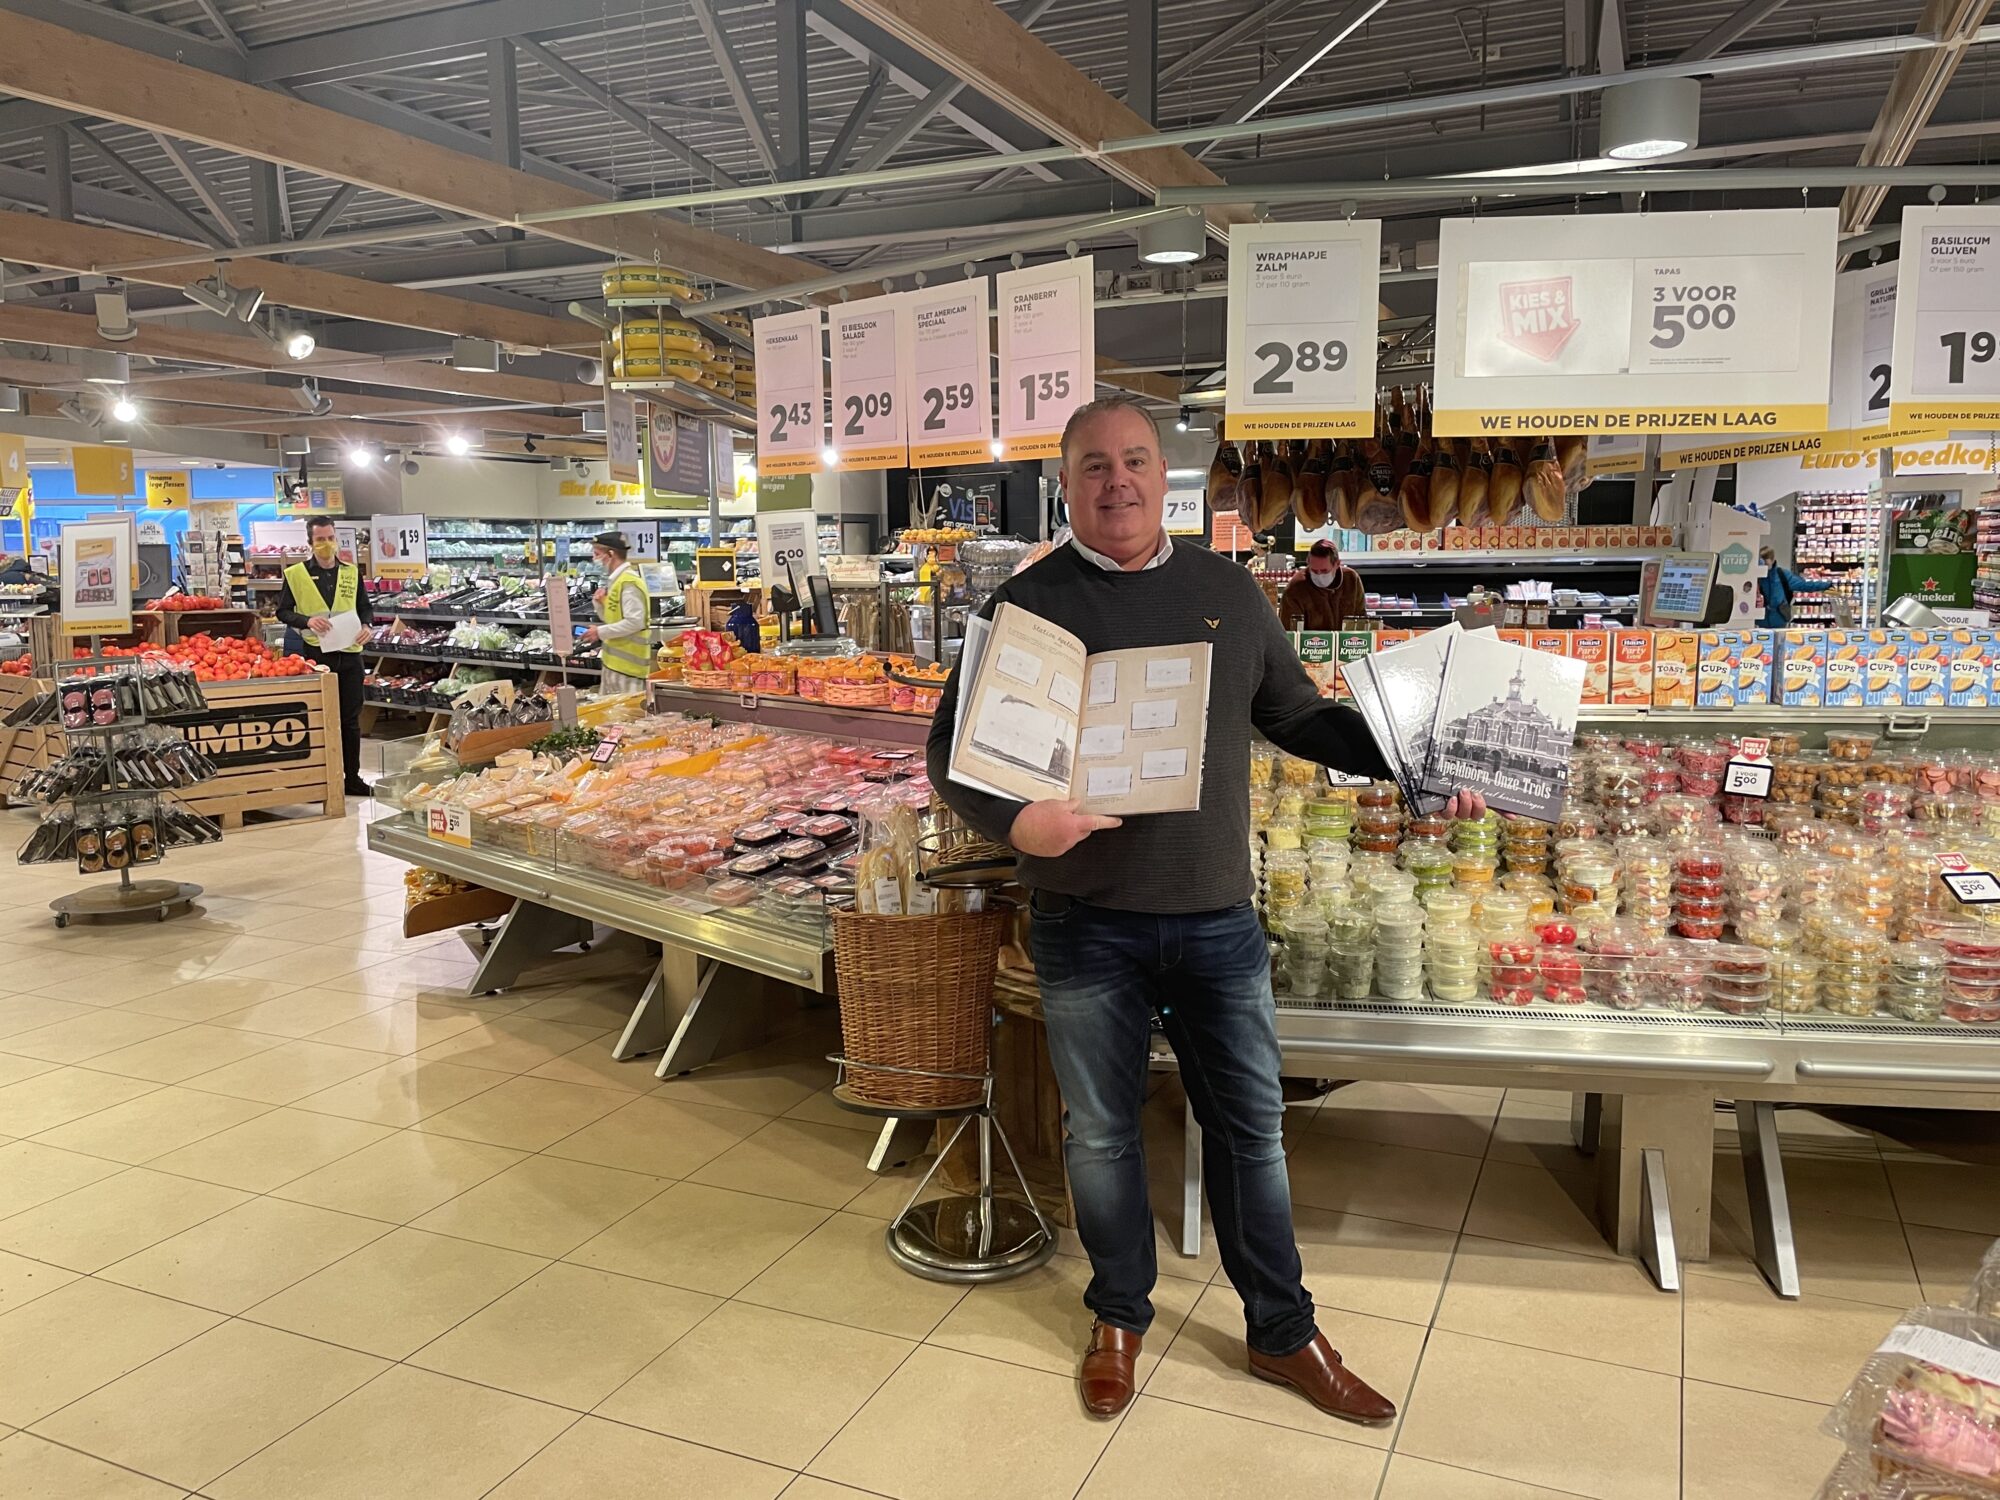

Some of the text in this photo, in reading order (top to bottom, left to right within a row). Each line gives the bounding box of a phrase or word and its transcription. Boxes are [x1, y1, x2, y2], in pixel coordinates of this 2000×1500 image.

[1931, 236, 1991, 245] BASILICUM
[1256, 250, 1328, 261] WRAPHAPJE
[1931, 246, 1977, 255] OLIJVEN
[1256, 263, 1287, 272] ZALM
[1014, 289, 1058, 304] CRANBERRY
[1653, 285, 1736, 302] 3 VOOR
[1509, 289, 1565, 310] KIES &
[918, 305, 967, 321] FILET AMERICAIN
[1014, 302, 1032, 313] PATÉ
[918, 318, 946, 329] SPECIAAL
[1511, 304, 1568, 336] MIX
[842, 321, 878, 333] EI BIESLOOK
[1649, 303, 1736, 349] 500
[766, 334, 798, 345] HEKSENKAAS
[842, 331, 865, 341] SALADE
[1940, 331, 2000, 384] 19
[1253, 340, 1348, 394] 289
[1019, 370, 1070, 421] 135
[923, 382, 974, 431] 259
[844, 391, 892, 436] 209
[770, 402, 811, 442] 243
[1480, 411, 1778, 430] WE HOUDEN DE PRIJZEN LAAG
[1871, 432, 1892, 440] HOUDEN
[1679, 438, 1821, 464] WE HOUDEN DE PRIJZEN LAAG
[9, 451, 19, 472] 4
[1800, 450, 1878, 470] Euro's
[120, 463, 128, 481] 5
[590, 480, 616, 500] dag
[762, 483, 785, 492] wegen
[1167, 501, 1196, 518] 750
[1899, 521, 1921, 529] 6-pack
[400, 529, 419, 556] 159
[637, 533, 654, 553] 119
[774, 548, 804, 567] 600
[1722, 557, 1748, 565] EITJES
[1904, 592, 1956, 601] Heineken
[1301, 647, 1330, 655] Krokant
[1340, 647, 1370, 655] Krokant
[1576, 647, 1601, 656] Party
[1621, 647, 1646, 656] Party
[1656, 664, 1684, 674] TOAST
[1700, 664, 1728, 674] CUPS
[1786, 663, 1813, 673] CUPS
[1829, 663, 1856, 673] CUPS
[1869, 663, 1895, 672] CUPS
[1910, 662, 1938, 672] CUPS
[1953, 663, 1980, 673] CUPS
[1744, 747, 1763, 755] MIX
[1437, 757, 1490, 786] Apeldoorn,
[1494, 770, 1520, 791] Onze
[1733, 776, 1757, 788] 500
[1944, 860, 1965, 868] MIX
[1960, 883, 1985, 895] 500
